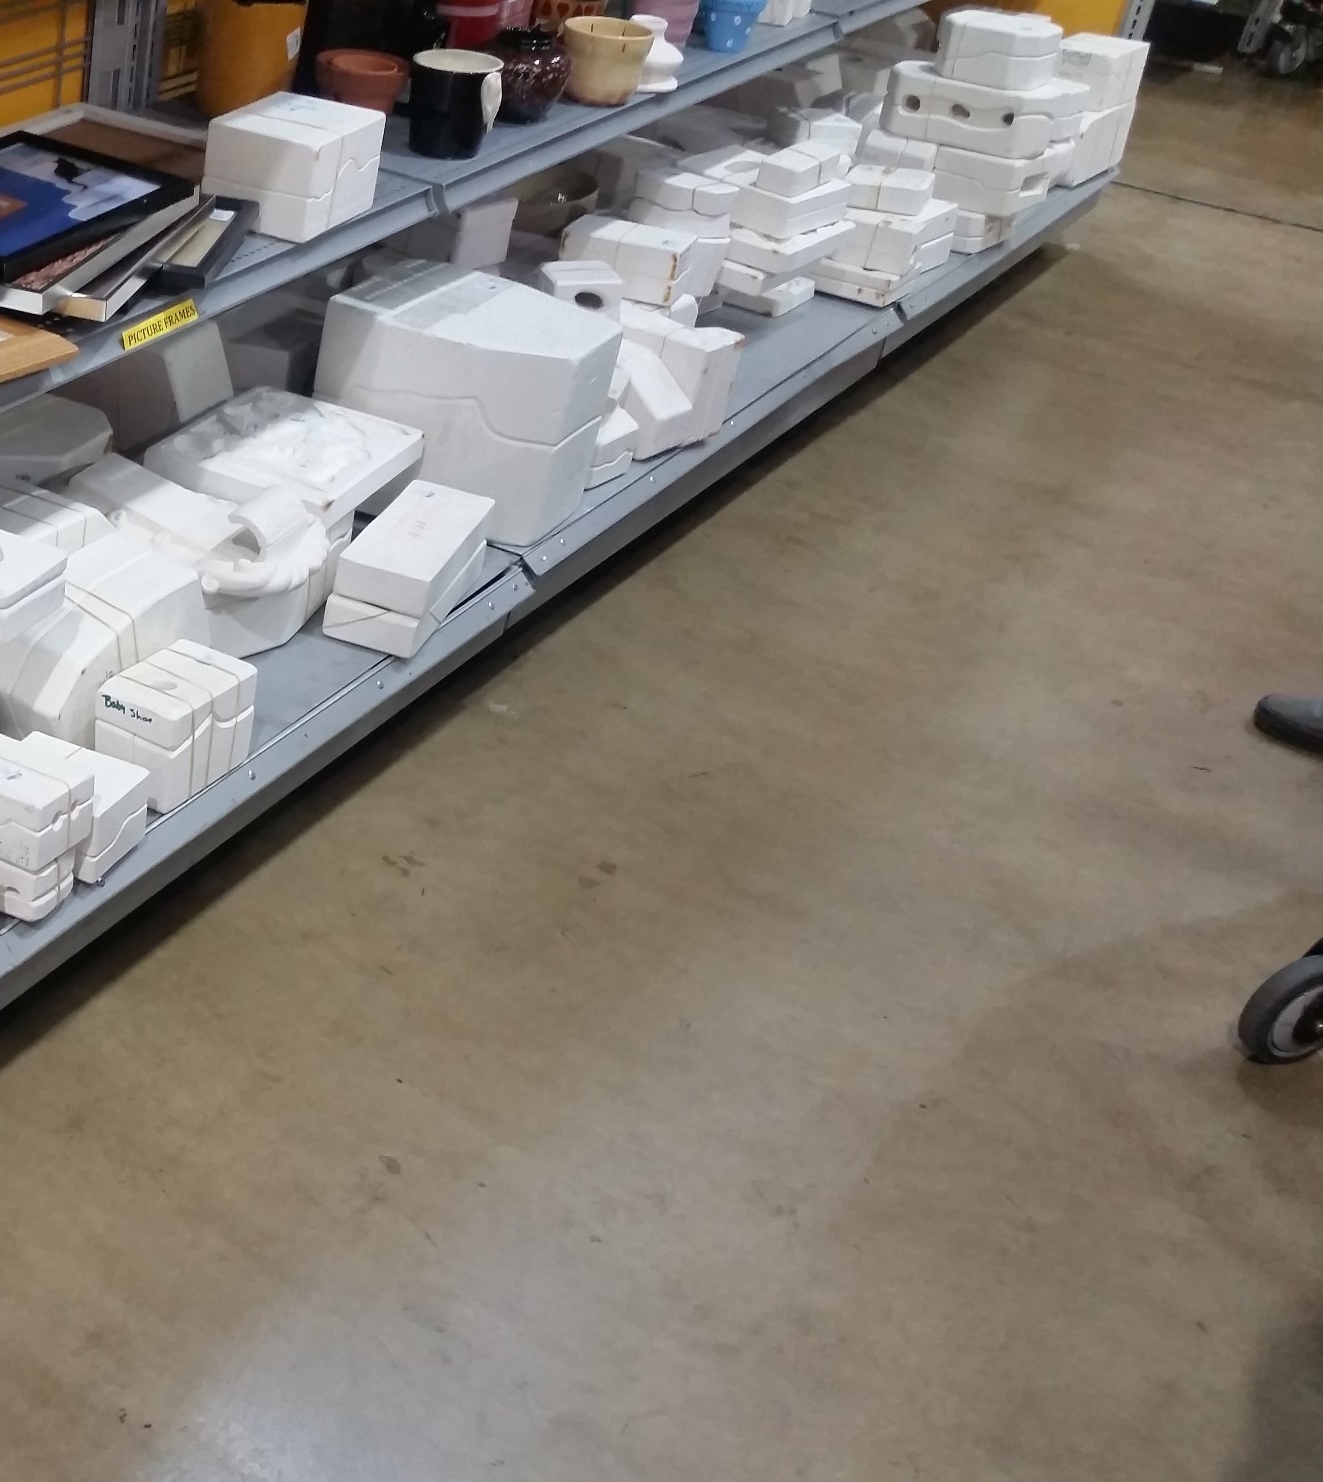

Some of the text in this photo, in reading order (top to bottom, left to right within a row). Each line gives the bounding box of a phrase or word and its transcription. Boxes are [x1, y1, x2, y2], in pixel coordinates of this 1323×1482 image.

[127, 304, 196, 347] PICTURE FRAMES
[101, 694, 126, 715] Baby
